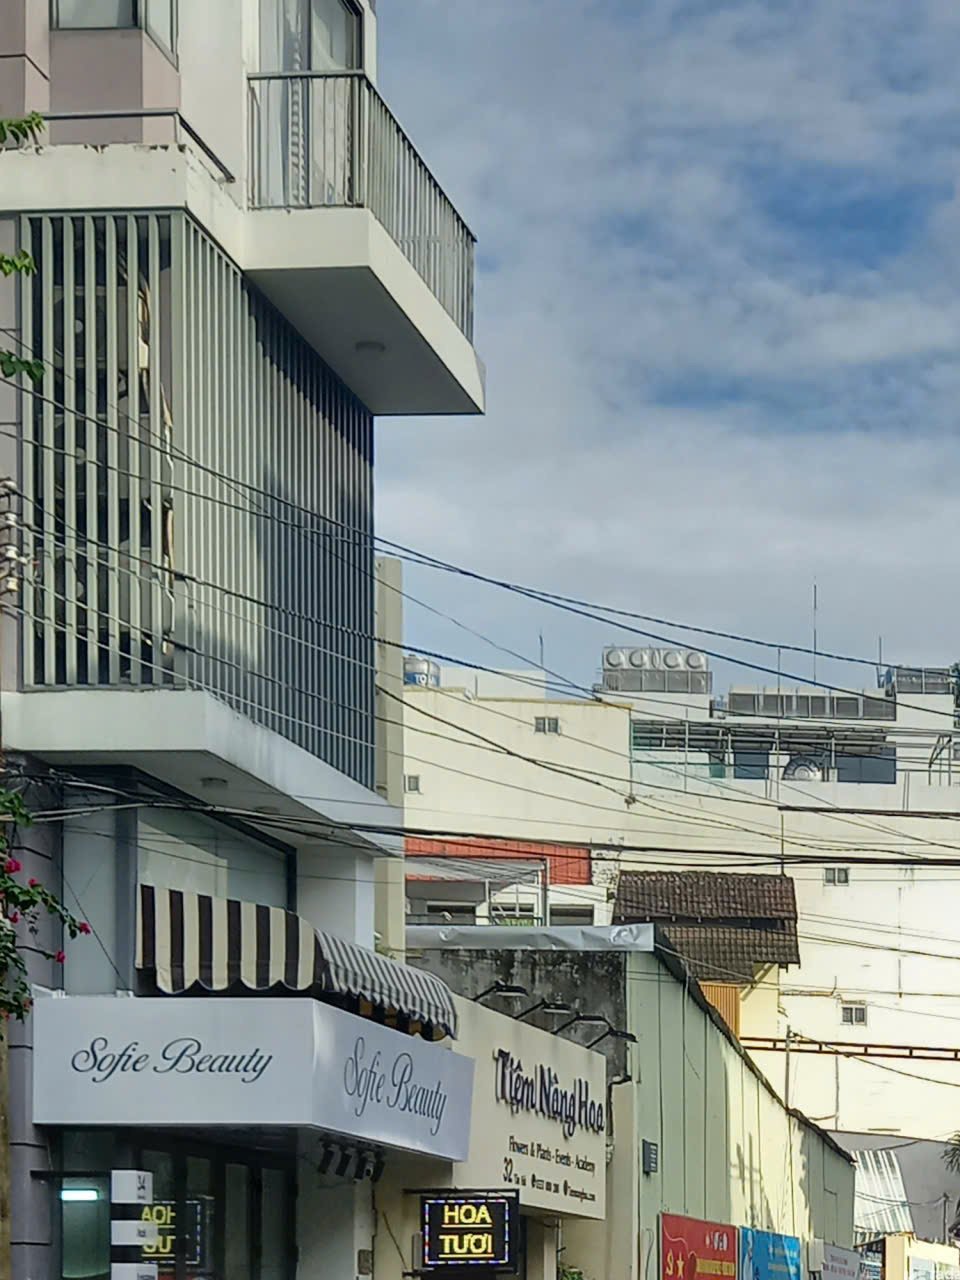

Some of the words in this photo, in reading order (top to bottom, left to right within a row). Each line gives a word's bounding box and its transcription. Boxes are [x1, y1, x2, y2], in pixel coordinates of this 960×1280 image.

[71, 1036, 149, 1083] Sofie
[153, 1037, 273, 1083] Beauty
[344, 1036, 386, 1117] Sofie
[386, 1052, 447, 1136] Beauty
[443, 1204, 493, 1224] HOA
[438, 1233, 493, 1254] TƯƠI
